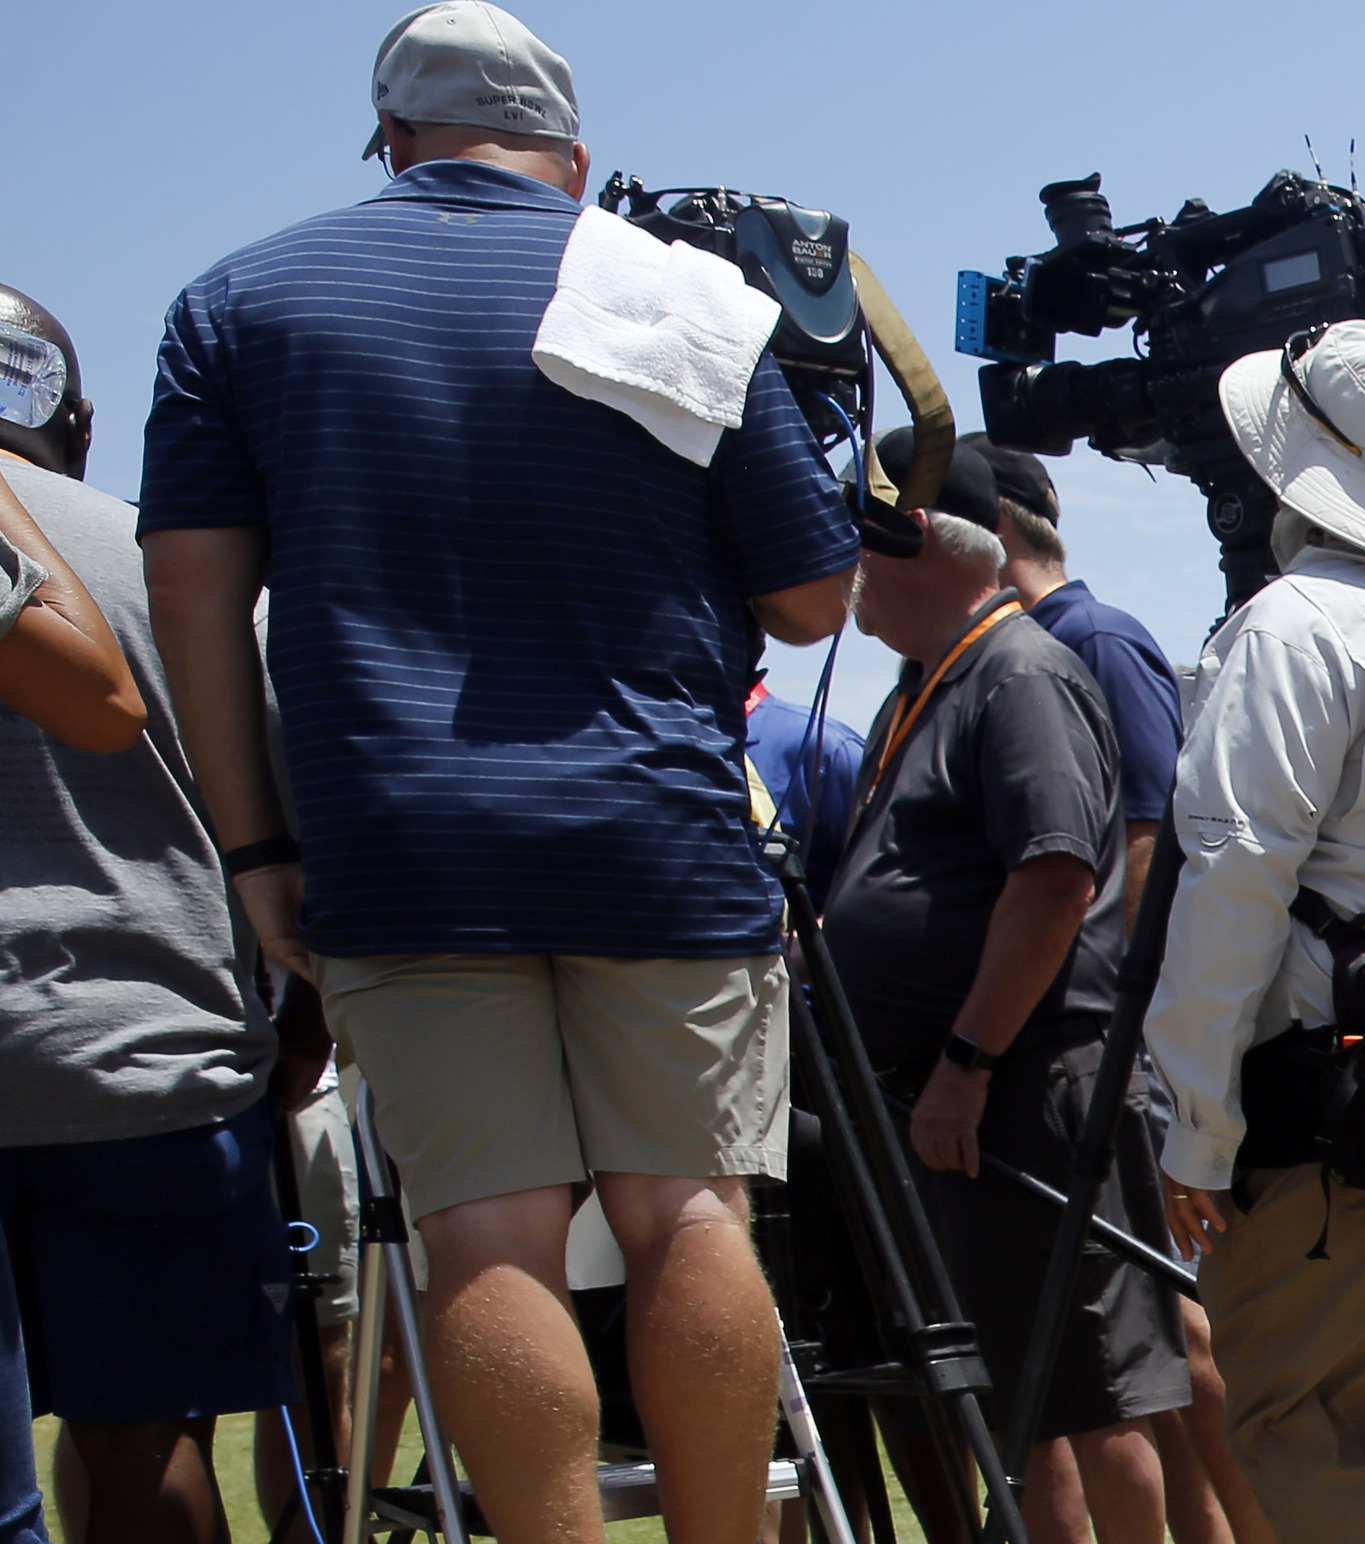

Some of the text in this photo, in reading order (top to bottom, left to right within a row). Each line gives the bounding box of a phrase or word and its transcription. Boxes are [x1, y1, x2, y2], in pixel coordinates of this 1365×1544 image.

[476, 94, 547, 119] SUPER BOWL
[504, 109, 524, 121] LVI
[792, 239, 832, 253] ANTON
